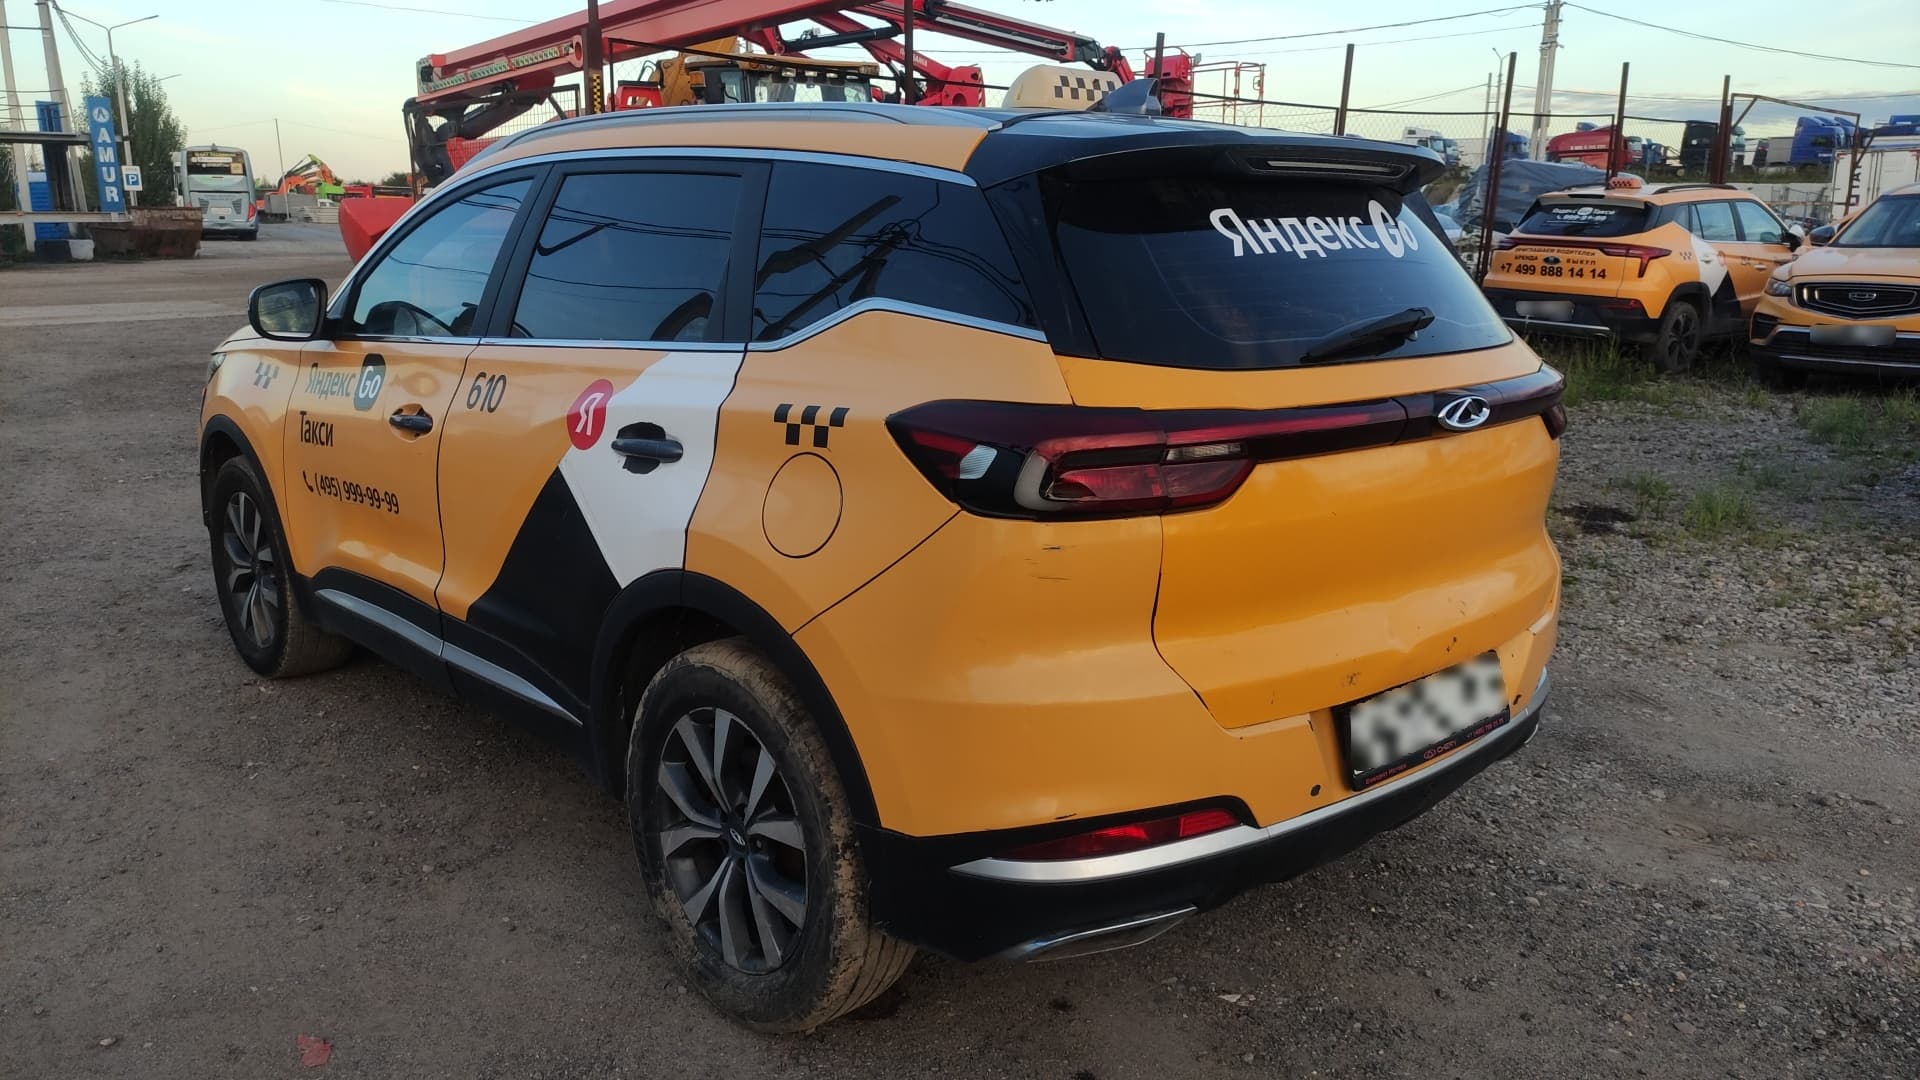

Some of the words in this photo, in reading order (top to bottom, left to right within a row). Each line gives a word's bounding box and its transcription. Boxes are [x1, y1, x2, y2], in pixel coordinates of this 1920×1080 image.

[97, 128, 119, 203] AMUR
[1209, 207, 1380, 259] Яндекс
[1368, 199, 1418, 257] Go
[1501, 262, 1512, 273] +7
[1515, 264, 1536, 275] 499
[1540, 266, 1563, 277] 888
[1568, 267, 1584, 278] 14
[1590, 268, 1607, 279] 14
[305, 362, 354, 399] Яндекс
[358, 364, 382, 399] Go
[466, 371, 507, 413] 610
[299, 410, 334, 447] Такси
[575, 392, 604, 436] Я
[314, 473, 342, 502] (495)
[343, 481, 400, 515] 999-99-99
